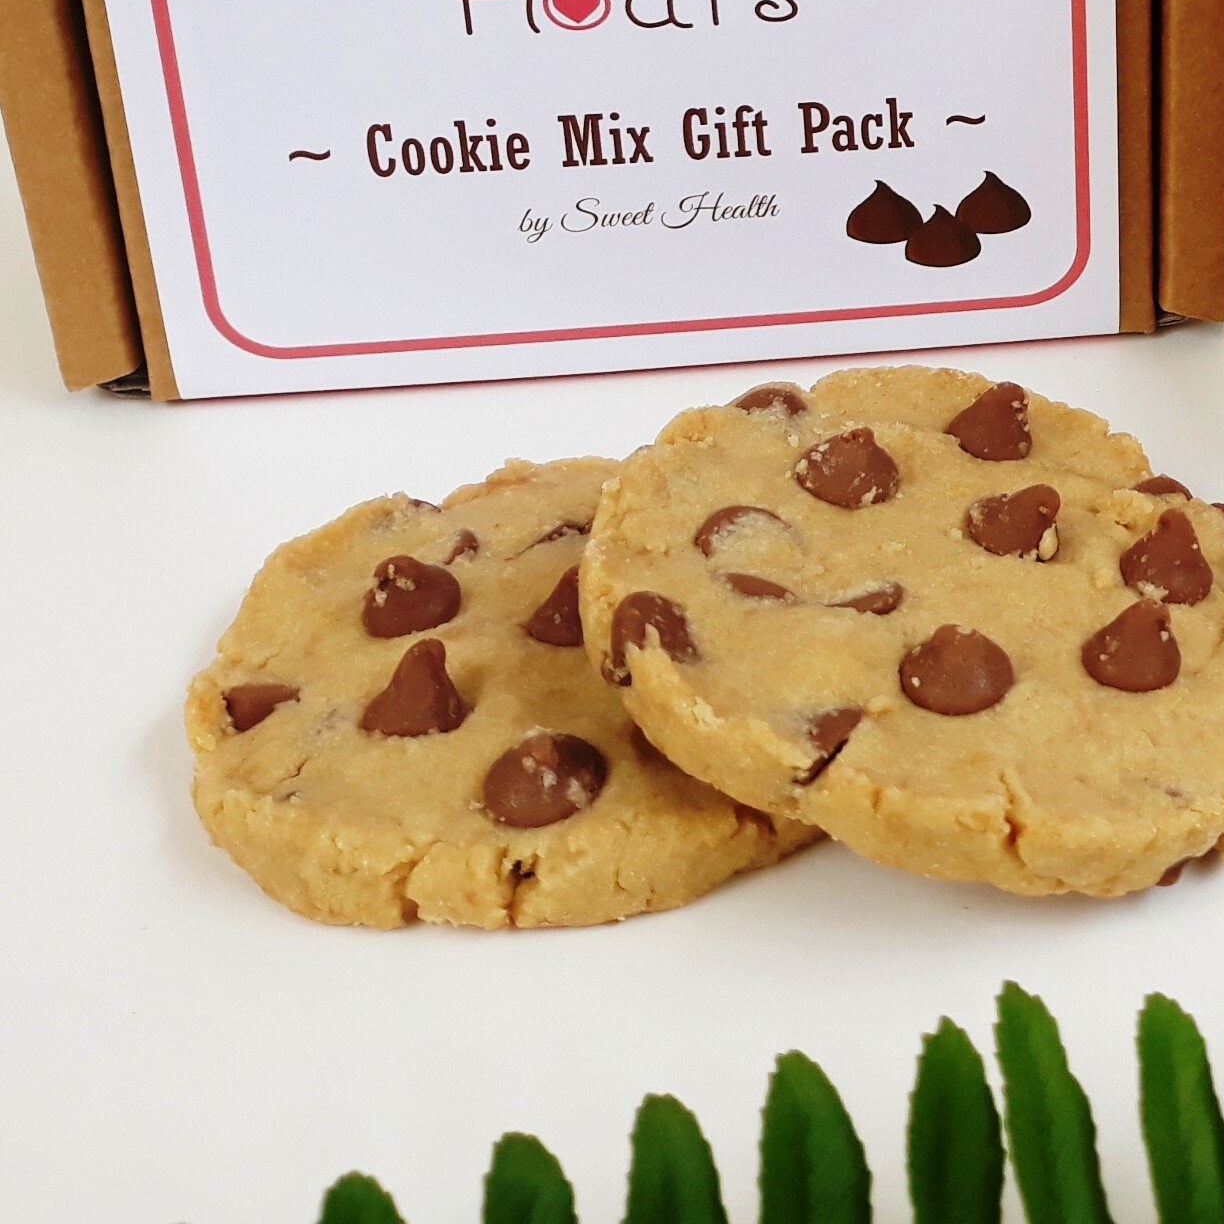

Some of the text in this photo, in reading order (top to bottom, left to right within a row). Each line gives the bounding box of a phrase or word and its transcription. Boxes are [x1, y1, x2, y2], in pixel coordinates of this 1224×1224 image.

[364, 118, 531, 177] Cookie
[557, 111, 654, 168] Mix
[681, 104, 769, 161] Gift
[799, 97, 916, 154] Pack
[518, 191, 781, 244] by Sweet Health
